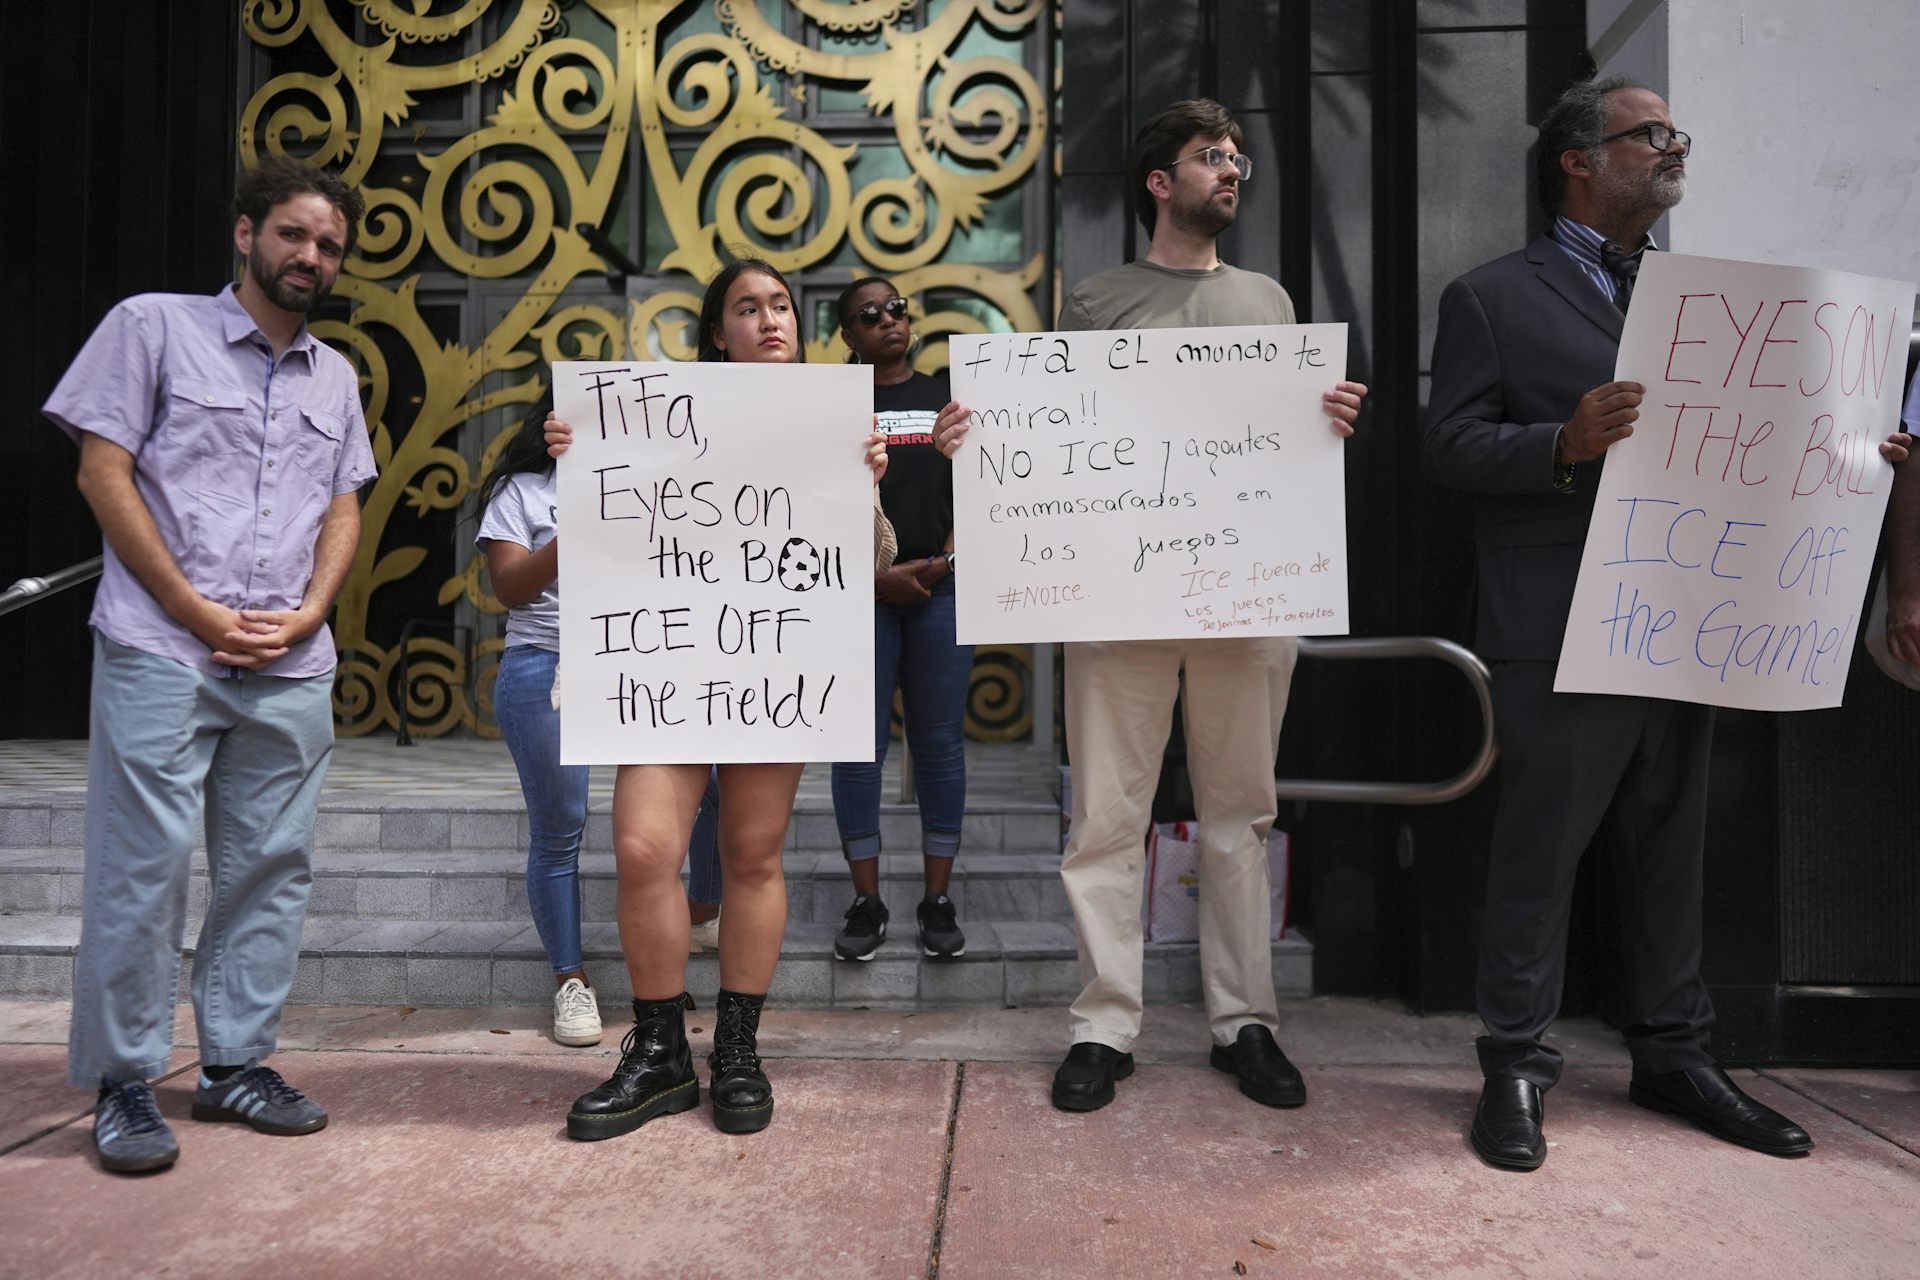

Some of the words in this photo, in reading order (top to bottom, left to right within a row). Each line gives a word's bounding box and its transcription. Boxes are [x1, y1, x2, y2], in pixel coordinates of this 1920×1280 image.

[1176, 339, 1277, 363] mundo
[1294, 334, 1326, 370] te
[1665, 294, 1838, 397] EYES
[1841, 304, 1897, 400] ON
[592, 465, 722, 542] Eyes
[734, 484, 791, 530] on
[648, 533, 720, 584] the
[1134, 528, 1239, 573] juegos
[1310, 552, 1330, 573] de
[1603, 497, 1766, 579] ICE
[590, 608, 695, 656] ICE
[717, 603, 812, 655] OFF
[1601, 582, 1680, 665] the
[606, 672, 686, 728] the
